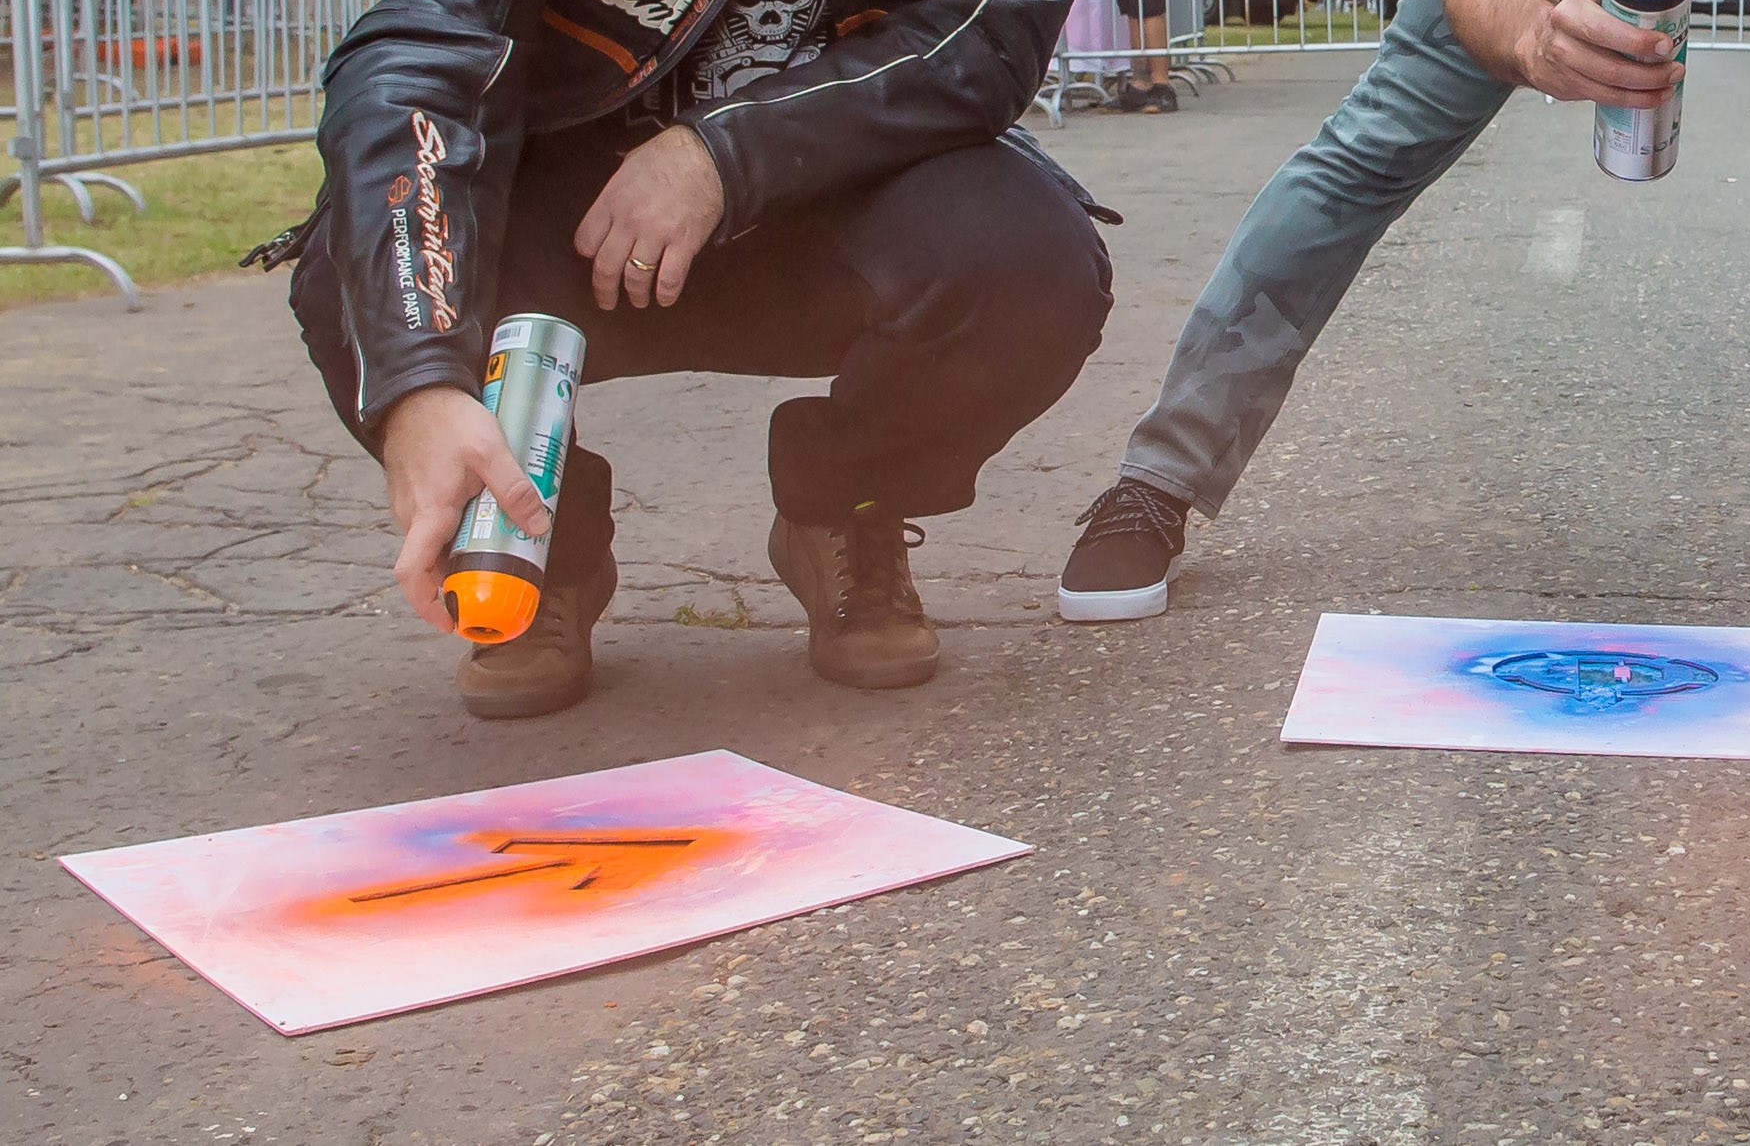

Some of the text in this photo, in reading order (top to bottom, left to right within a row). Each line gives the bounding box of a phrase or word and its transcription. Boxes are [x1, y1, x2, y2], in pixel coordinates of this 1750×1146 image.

[392, 208, 422, 330] PERFORMANCE PARTS
[415, 248, 458, 333] Eagle
[524, 352, 578, 383] PPEC
